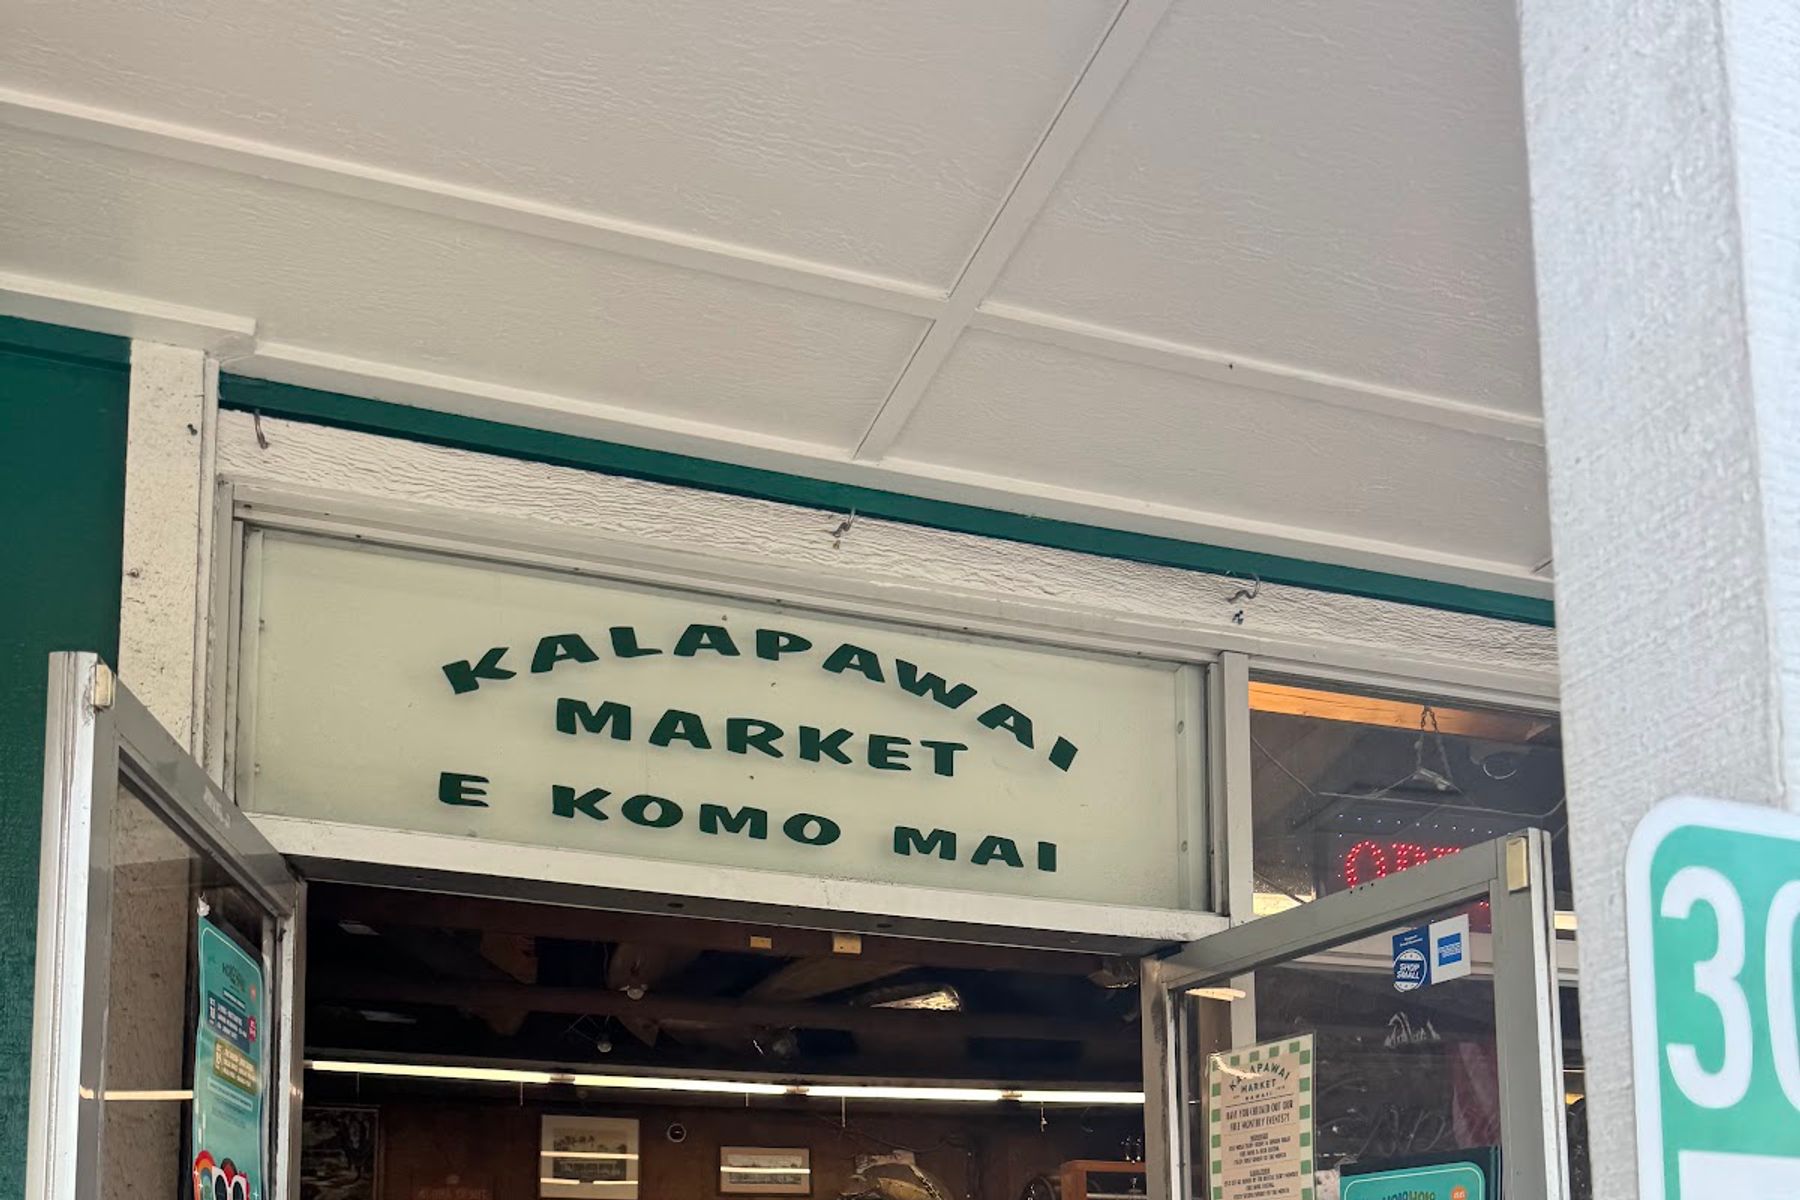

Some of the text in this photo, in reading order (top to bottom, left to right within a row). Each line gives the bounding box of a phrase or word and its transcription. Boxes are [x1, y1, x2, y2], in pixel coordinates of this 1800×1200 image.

[443, 623, 1078, 772] KALAPAWAI
[555, 697, 969, 777] MARKET
[438, 771, 1058, 873] E KOMO MAI
[1346, 841, 1461, 889] OP
[1241, 1078, 1276, 1093] MARKET
